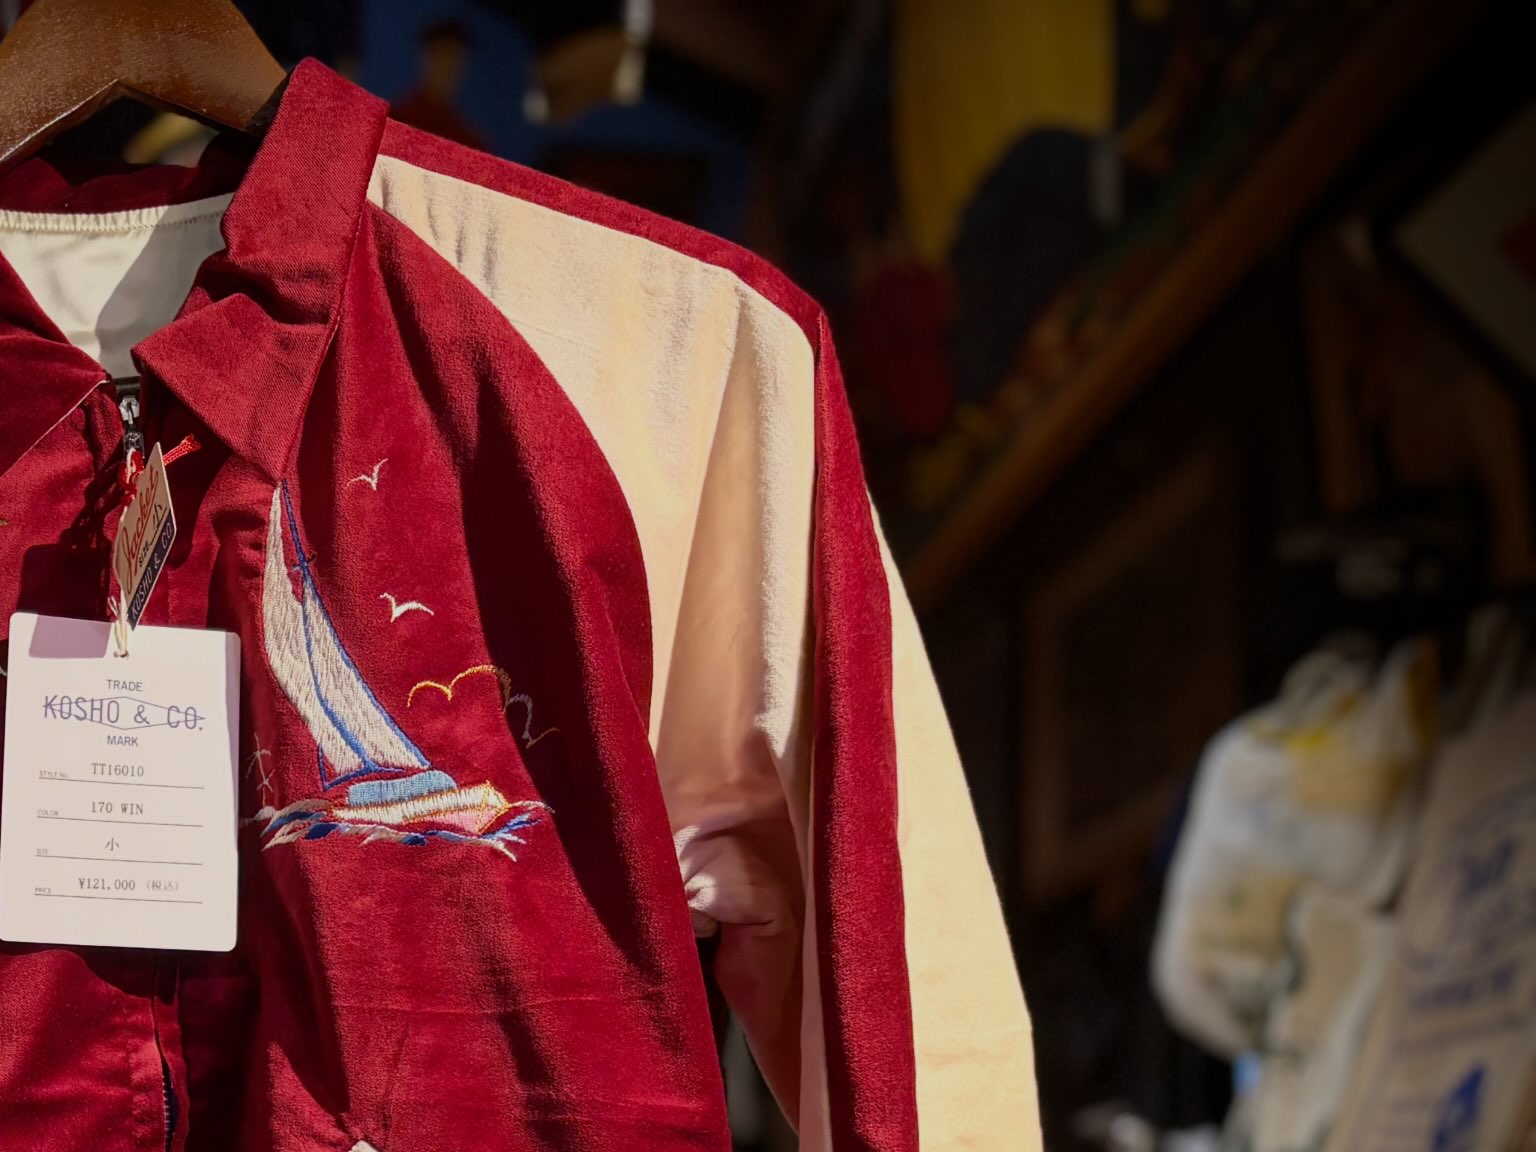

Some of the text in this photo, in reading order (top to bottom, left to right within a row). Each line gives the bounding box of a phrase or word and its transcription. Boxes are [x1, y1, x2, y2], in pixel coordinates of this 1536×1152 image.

[122, 465, 159, 595] Jacket
[131, 567, 153, 620] KOSHO
[107, 679, 143, 692] TRADE
[44, 695, 203, 731] KOSHO & CO.
[107, 735, 139, 747] MARK
[91, 762, 144, 777] TT16010
[91, 801, 144, 815] 170 WIN
[105, 837, 120, 851] 小
[78, 877, 136, 891] ¥121,000
